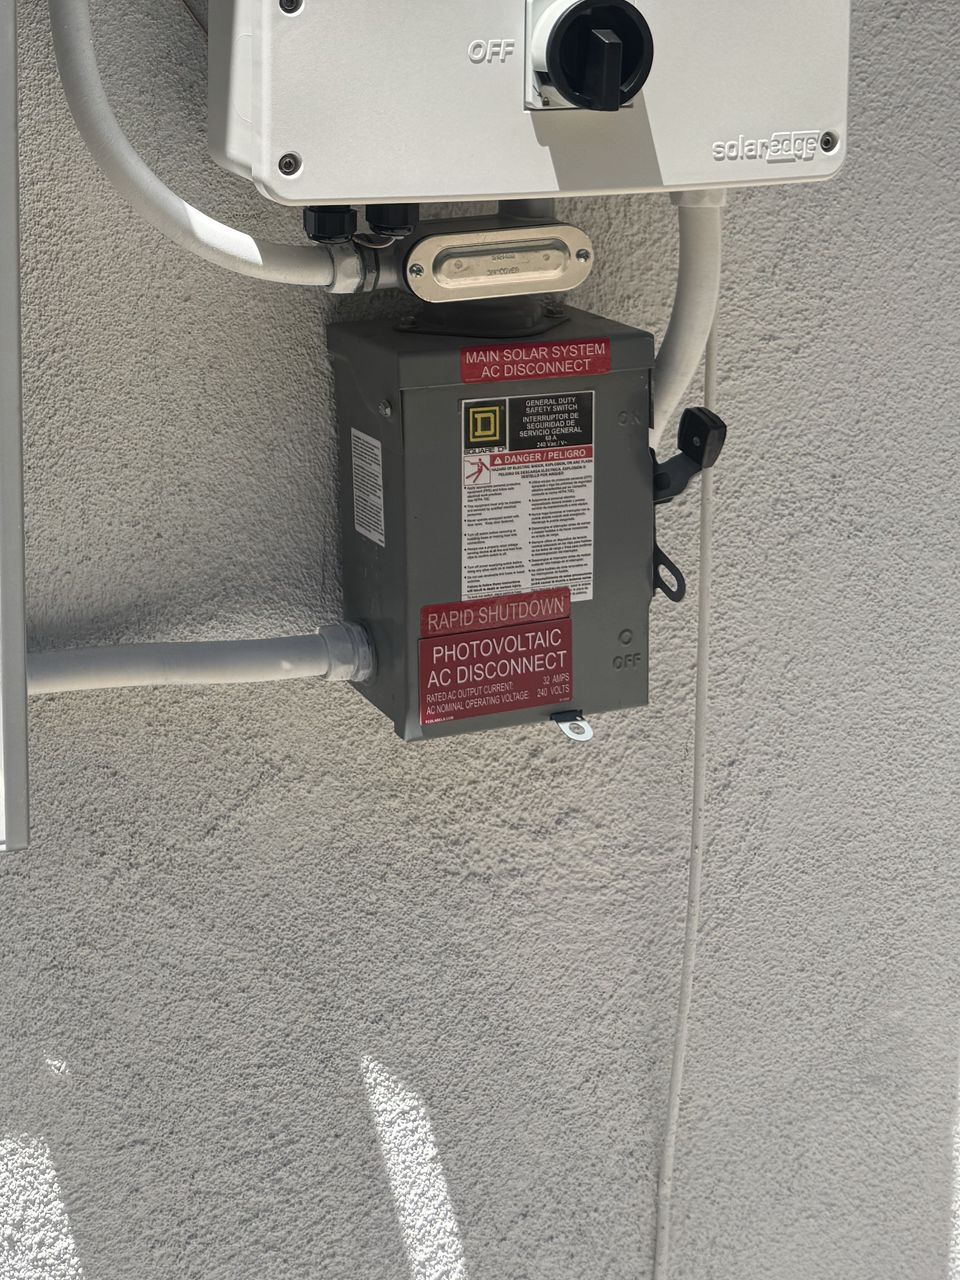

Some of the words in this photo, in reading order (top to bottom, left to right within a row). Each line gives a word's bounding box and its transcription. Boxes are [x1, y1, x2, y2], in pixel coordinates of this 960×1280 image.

[468, 39, 514, 63] OFF
[466, 350, 498, 363] MAIN
[503, 347, 547, 361] SOLAR
[552, 343, 604, 357] SYSTEM
[481, 365, 499, 377] AC
[504, 358, 589, 376] DISCONNECT
[525, 398, 556, 406] GENERAL
[558, 396, 575, 404] DUTY
[525, 405, 550, 413] SAFETY
[552, 403, 577, 411] SWITCH
[504, 452, 541, 463] DANGER
[542, 452, 546, 460] /
[548, 448, 585, 459] PELIGRO
[428, 609, 473, 629] RAPID
[478, 597, 563, 623] SHUTDOWN
[433, 629, 560, 662] PHOTOVOLTAIC
[427, 668, 450, 687] AC
[457, 650, 565, 682] DISCONNECT
[543, 675, 550, 684] 32
[552, 672, 569, 683] AMPS
[536, 687, 547, 697] 240
[550, 684, 569, 694] VOLTS
